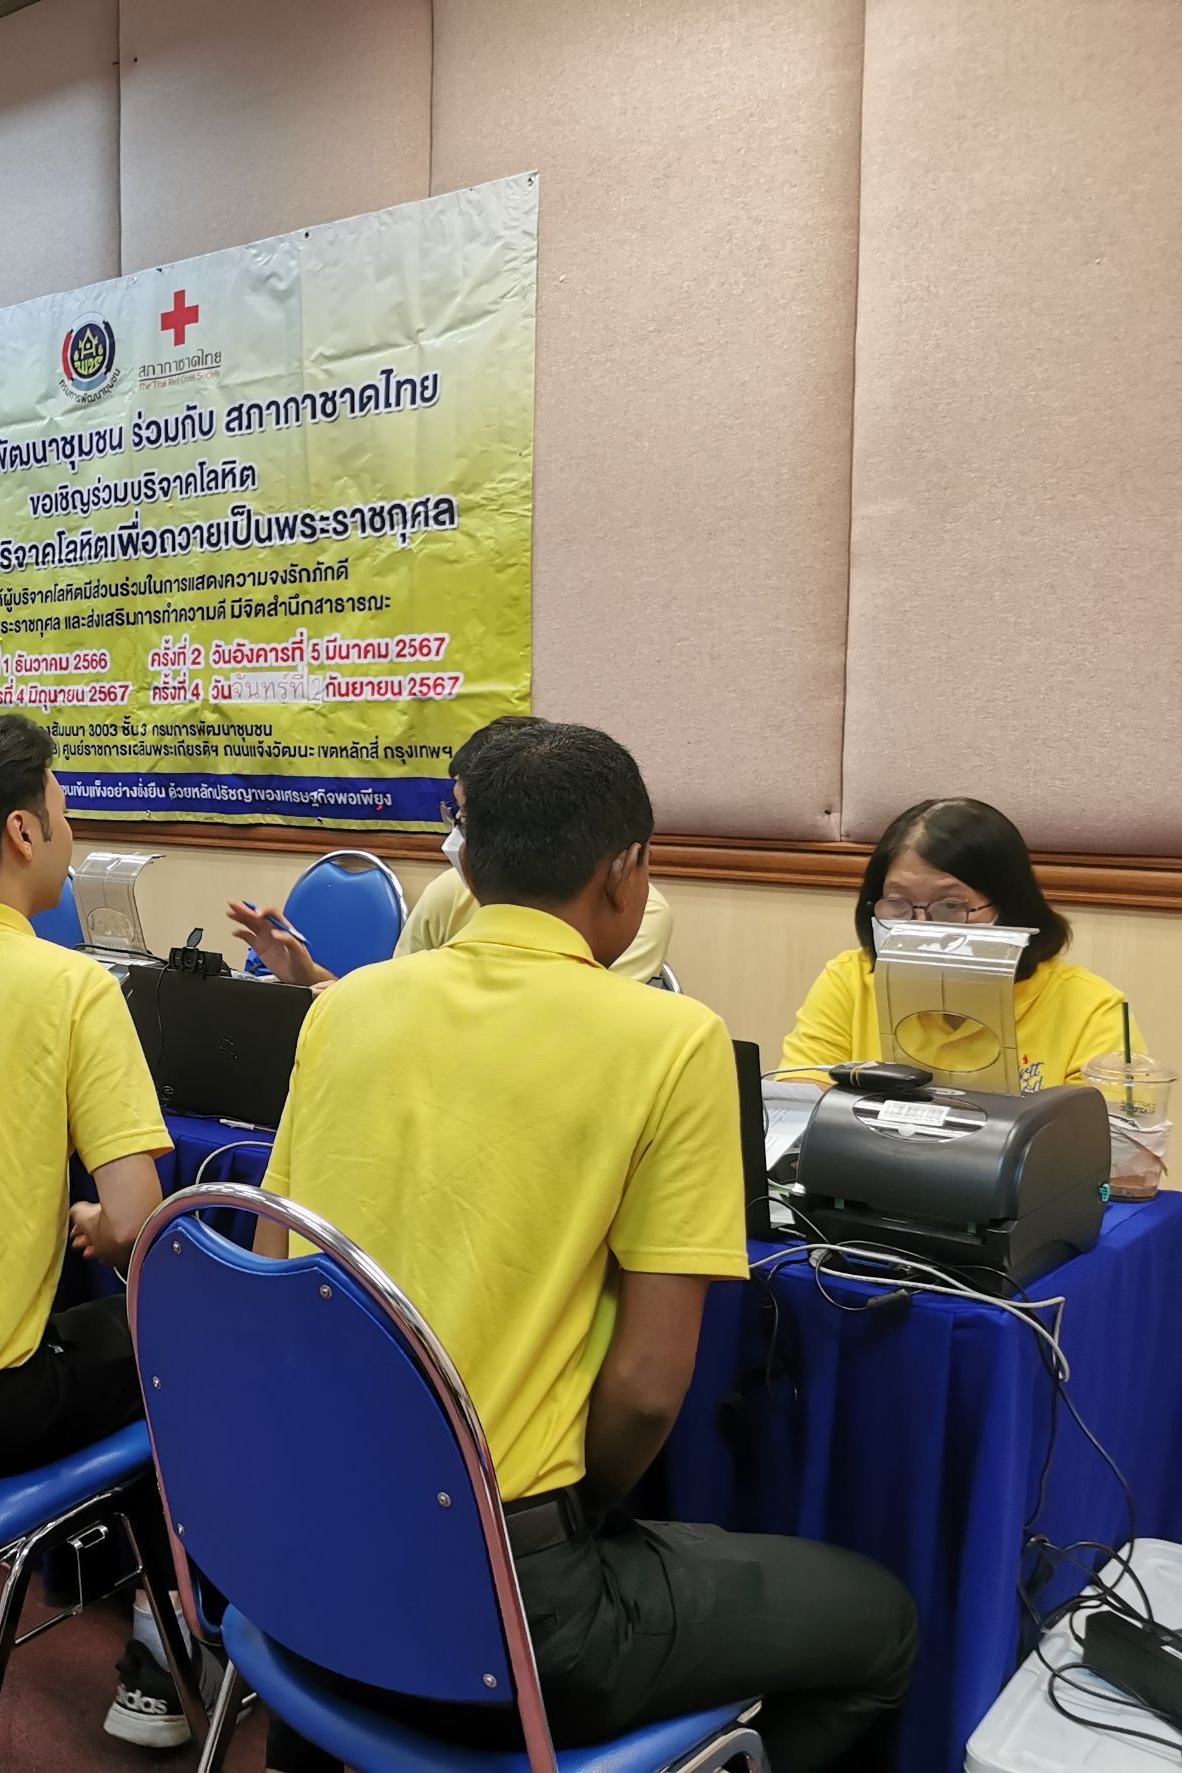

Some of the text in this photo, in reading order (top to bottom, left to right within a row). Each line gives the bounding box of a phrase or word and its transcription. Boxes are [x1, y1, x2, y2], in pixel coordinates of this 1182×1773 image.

[139, 348, 222, 378] สภากาชาดไทย
[132, 404, 214, 447] ร่วมกับ
[225, 368, 439, 433] สภากาชาดไทย
[29, 460, 256, 516] ขอเชิญร่วมบริจาคโลหิต
[64, 603, 226, 631] และส่งเสริมการทำความดี
[230, 593, 391, 619] มีจิตสำนึกสาธารณะ
[4, 658, 9, 674] 1
[15, 652, 69, 674] ธันวาคม
[74, 652, 108, 672] 2566
[151, 632, 446, 668] ครั้งที่ 2 วันอังคารที่ 5 มีนาคม 2567
[17, 690, 25, 705] 4
[29, 685, 85, 711] มิถุนายน
[89, 684, 130, 703] 2567
[152, 671, 189, 701] ครั้งที่
[191, 683, 201, 700] 4
[326, 675, 402, 698] กันยายน
[407, 675, 461, 697] 2567
[89, 724, 118, 737] 3003
[152, 720, 273, 741] กรมการพัฒนาชุมชน
[223, 740, 315, 759] ถนนแจ้งวัฒนะ
[318, 735, 379, 759] เขตหลักสี่
[383, 744, 453, 765] กรุงเทพฯ
[168, 782, 392, 808] ด้วยหลักปรัชญาของเศรษฐกิจพอเพียง
